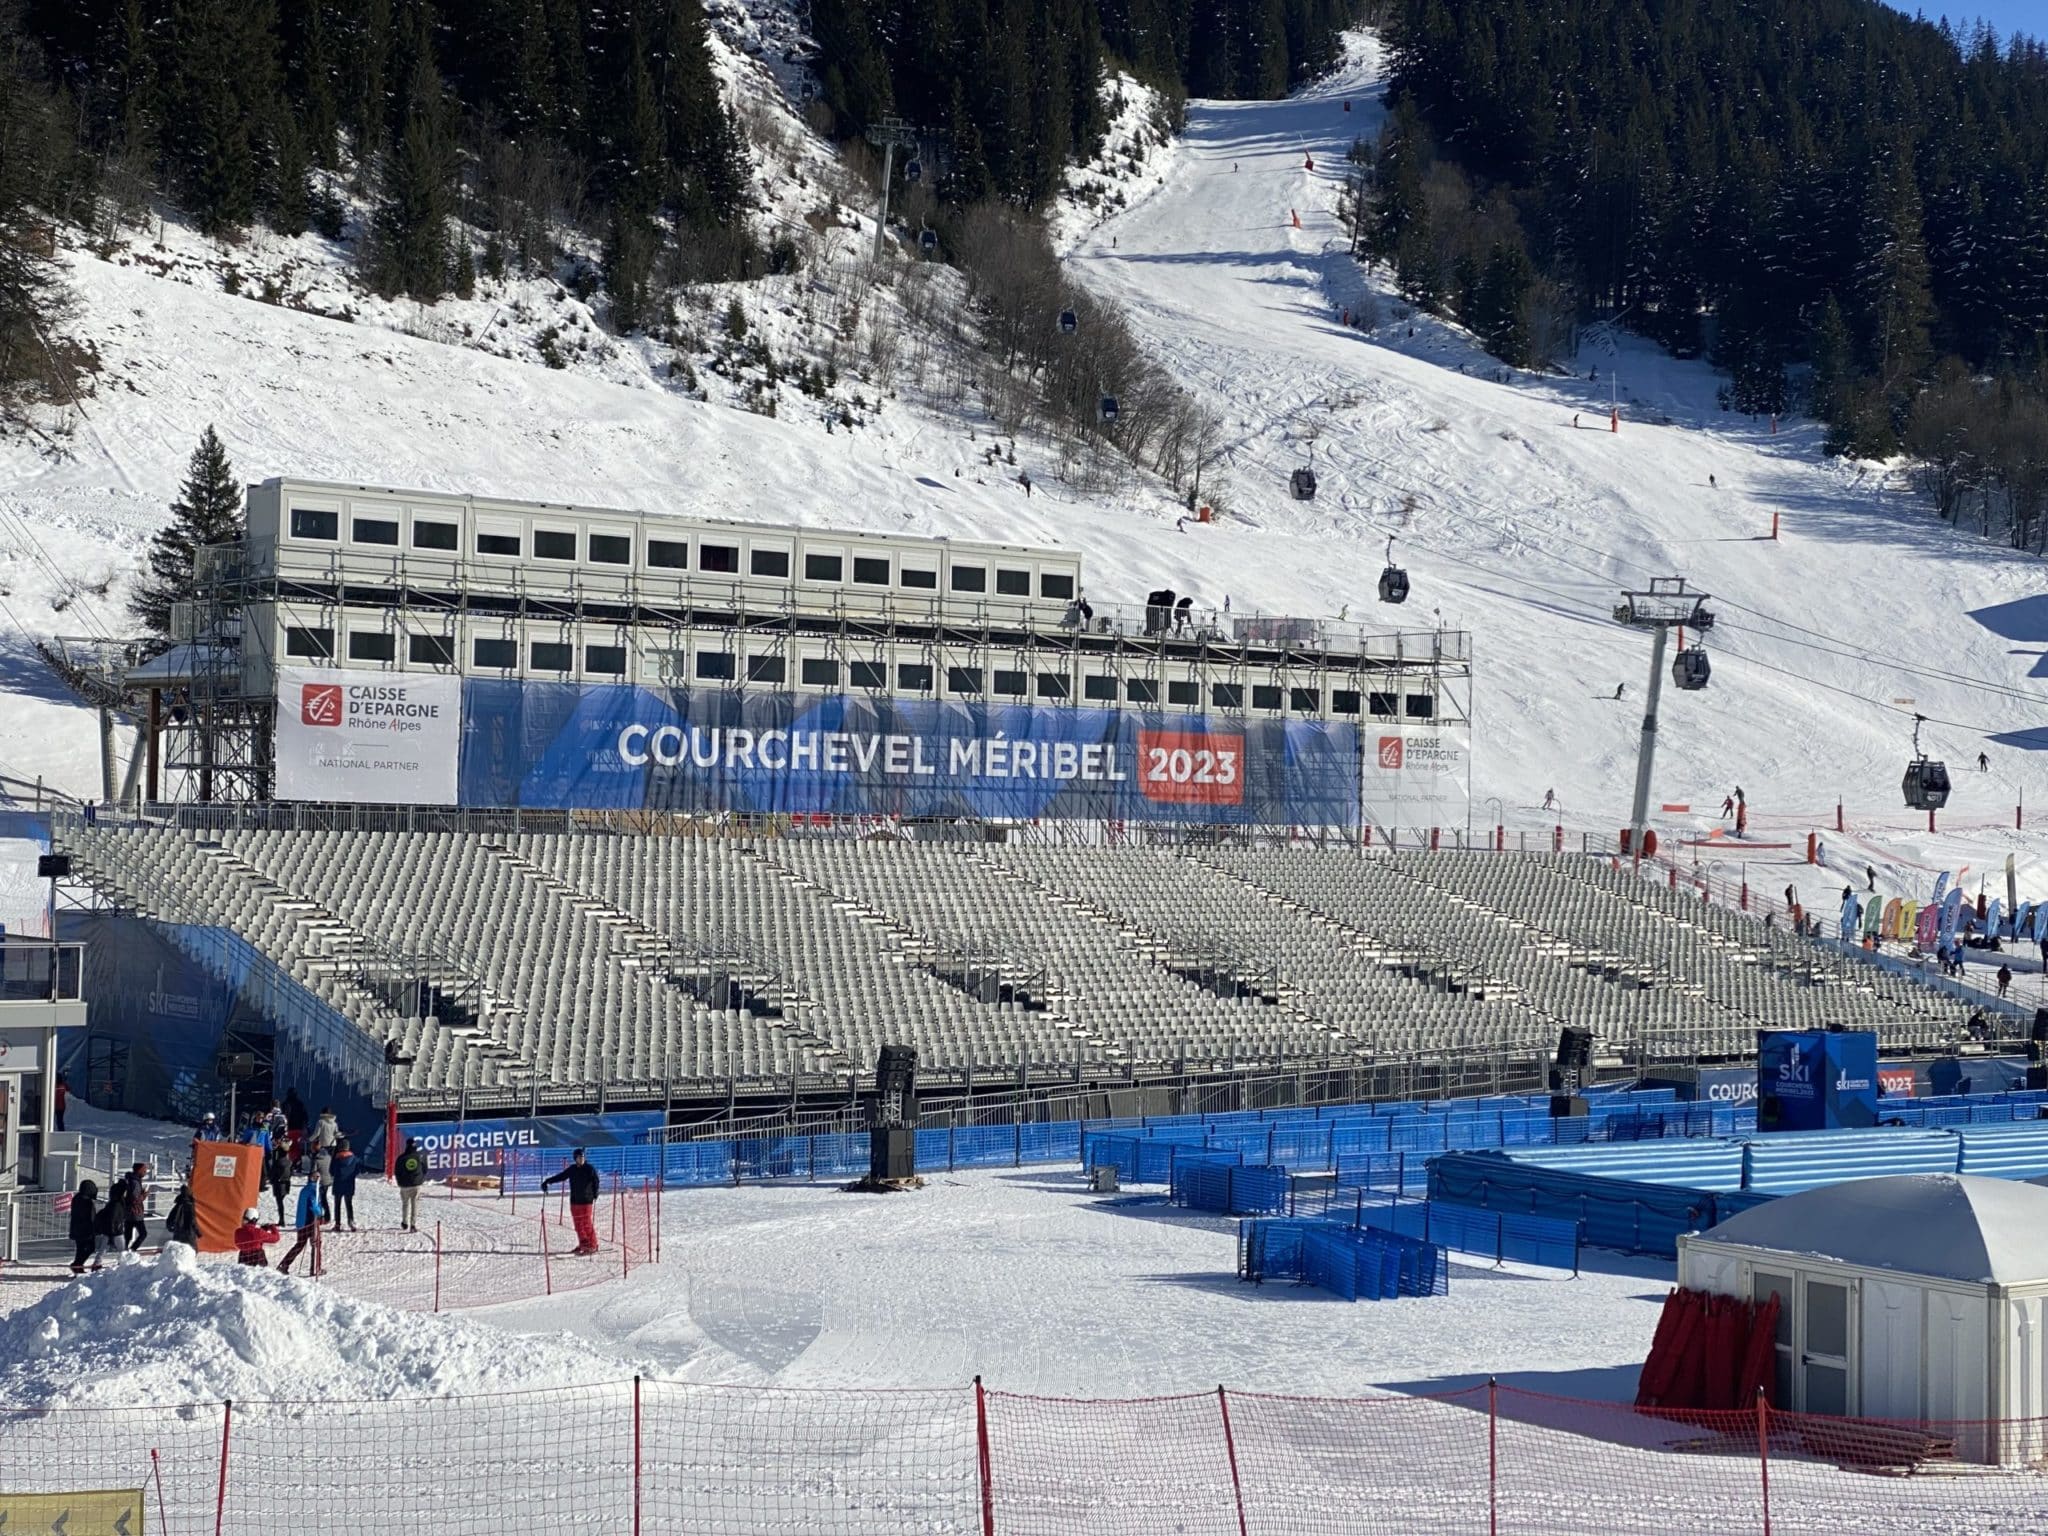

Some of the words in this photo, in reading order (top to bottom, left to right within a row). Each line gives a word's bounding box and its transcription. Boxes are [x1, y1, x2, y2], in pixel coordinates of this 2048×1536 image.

[349, 685, 407, 701] CAISSE
[349, 701, 439, 718] D'EPARGNE
[348, 717, 386, 730] Rhône
[388, 718, 422, 733] Alpes
[1406, 737, 1441, 748] CAISSE
[618, 723, 936, 776] COURCHEVEL
[949, 731, 1126, 782] MÉRIBEL
[1147, 747, 1236, 785] 2023
[1406, 749, 1459, 761] D'EPARGNE
[319, 759, 370, 770] NATIONAL
[373, 760, 419, 771] PARTNER
[413, 1129, 540, 1152] COURCHEVEL
[426, 1150, 495, 1170] ÉRIBEL
